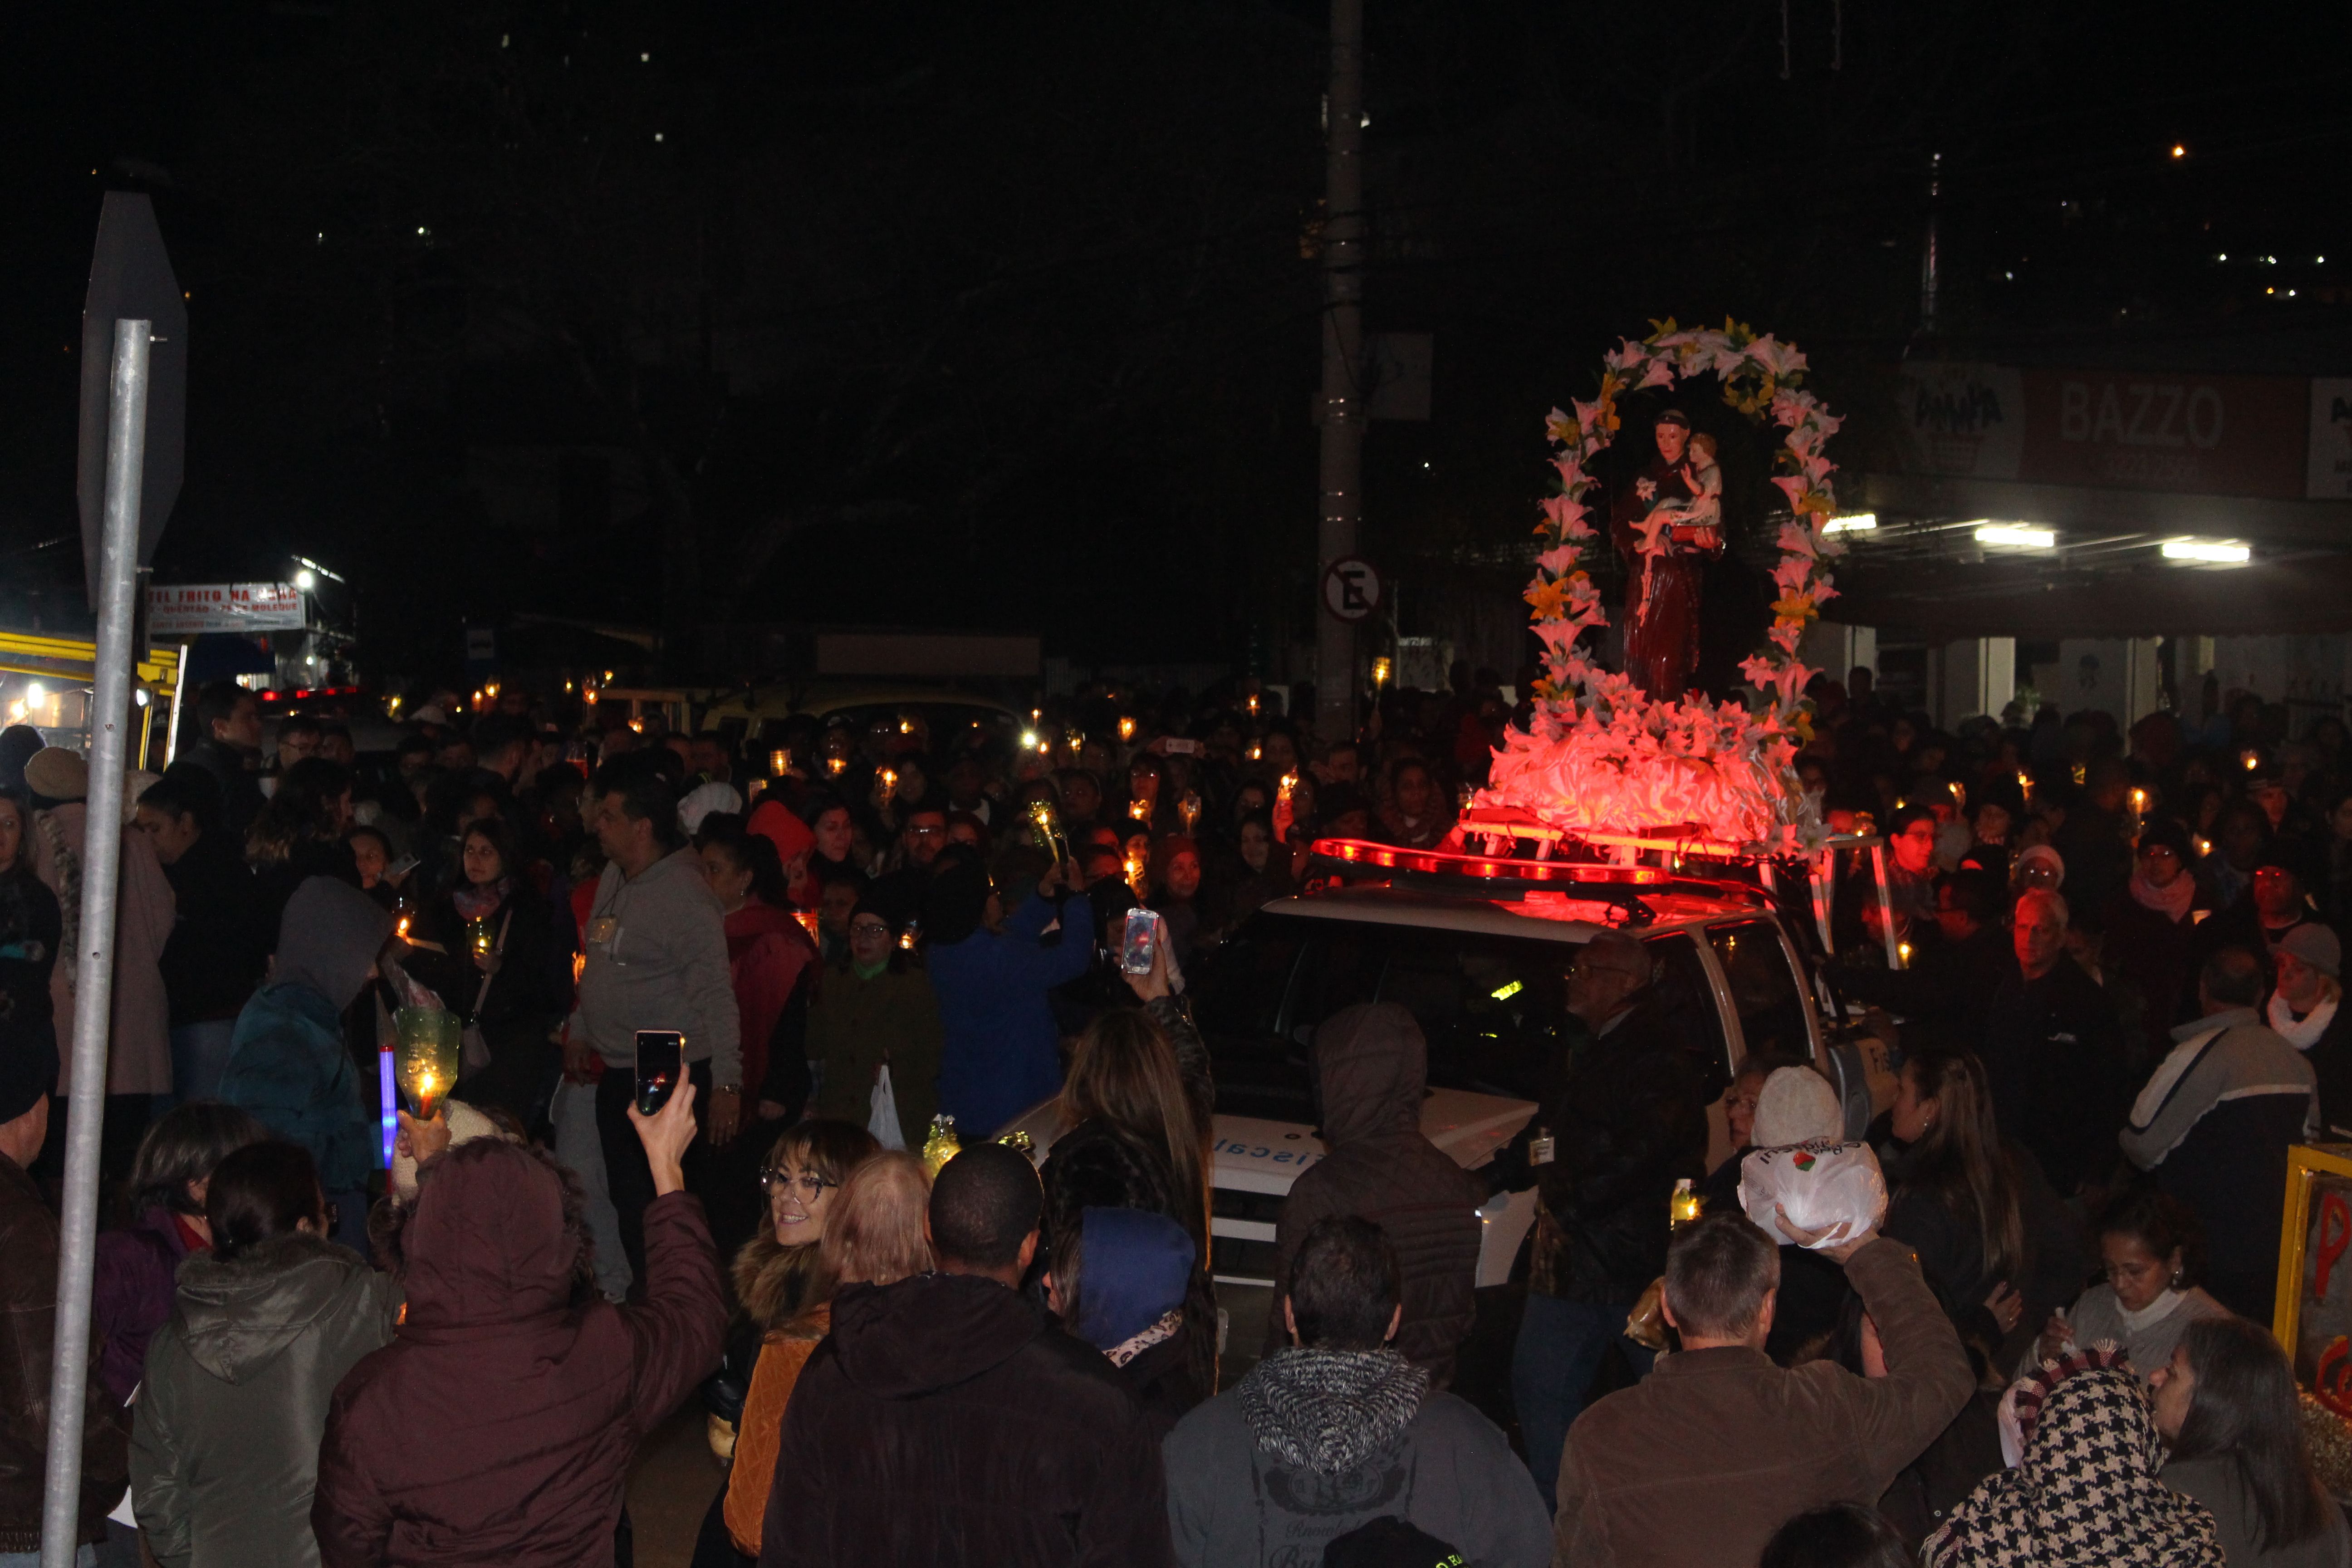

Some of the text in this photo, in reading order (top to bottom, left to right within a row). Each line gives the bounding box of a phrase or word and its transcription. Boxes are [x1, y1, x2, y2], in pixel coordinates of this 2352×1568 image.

[2061, 380, 2223, 449] BAZZO
[179, 590, 221, 603] FRITO
[231, 589, 250, 602] NA
[1343, 571, 1365, 610] E
[252, 603, 297, 612] MOLEQUE
